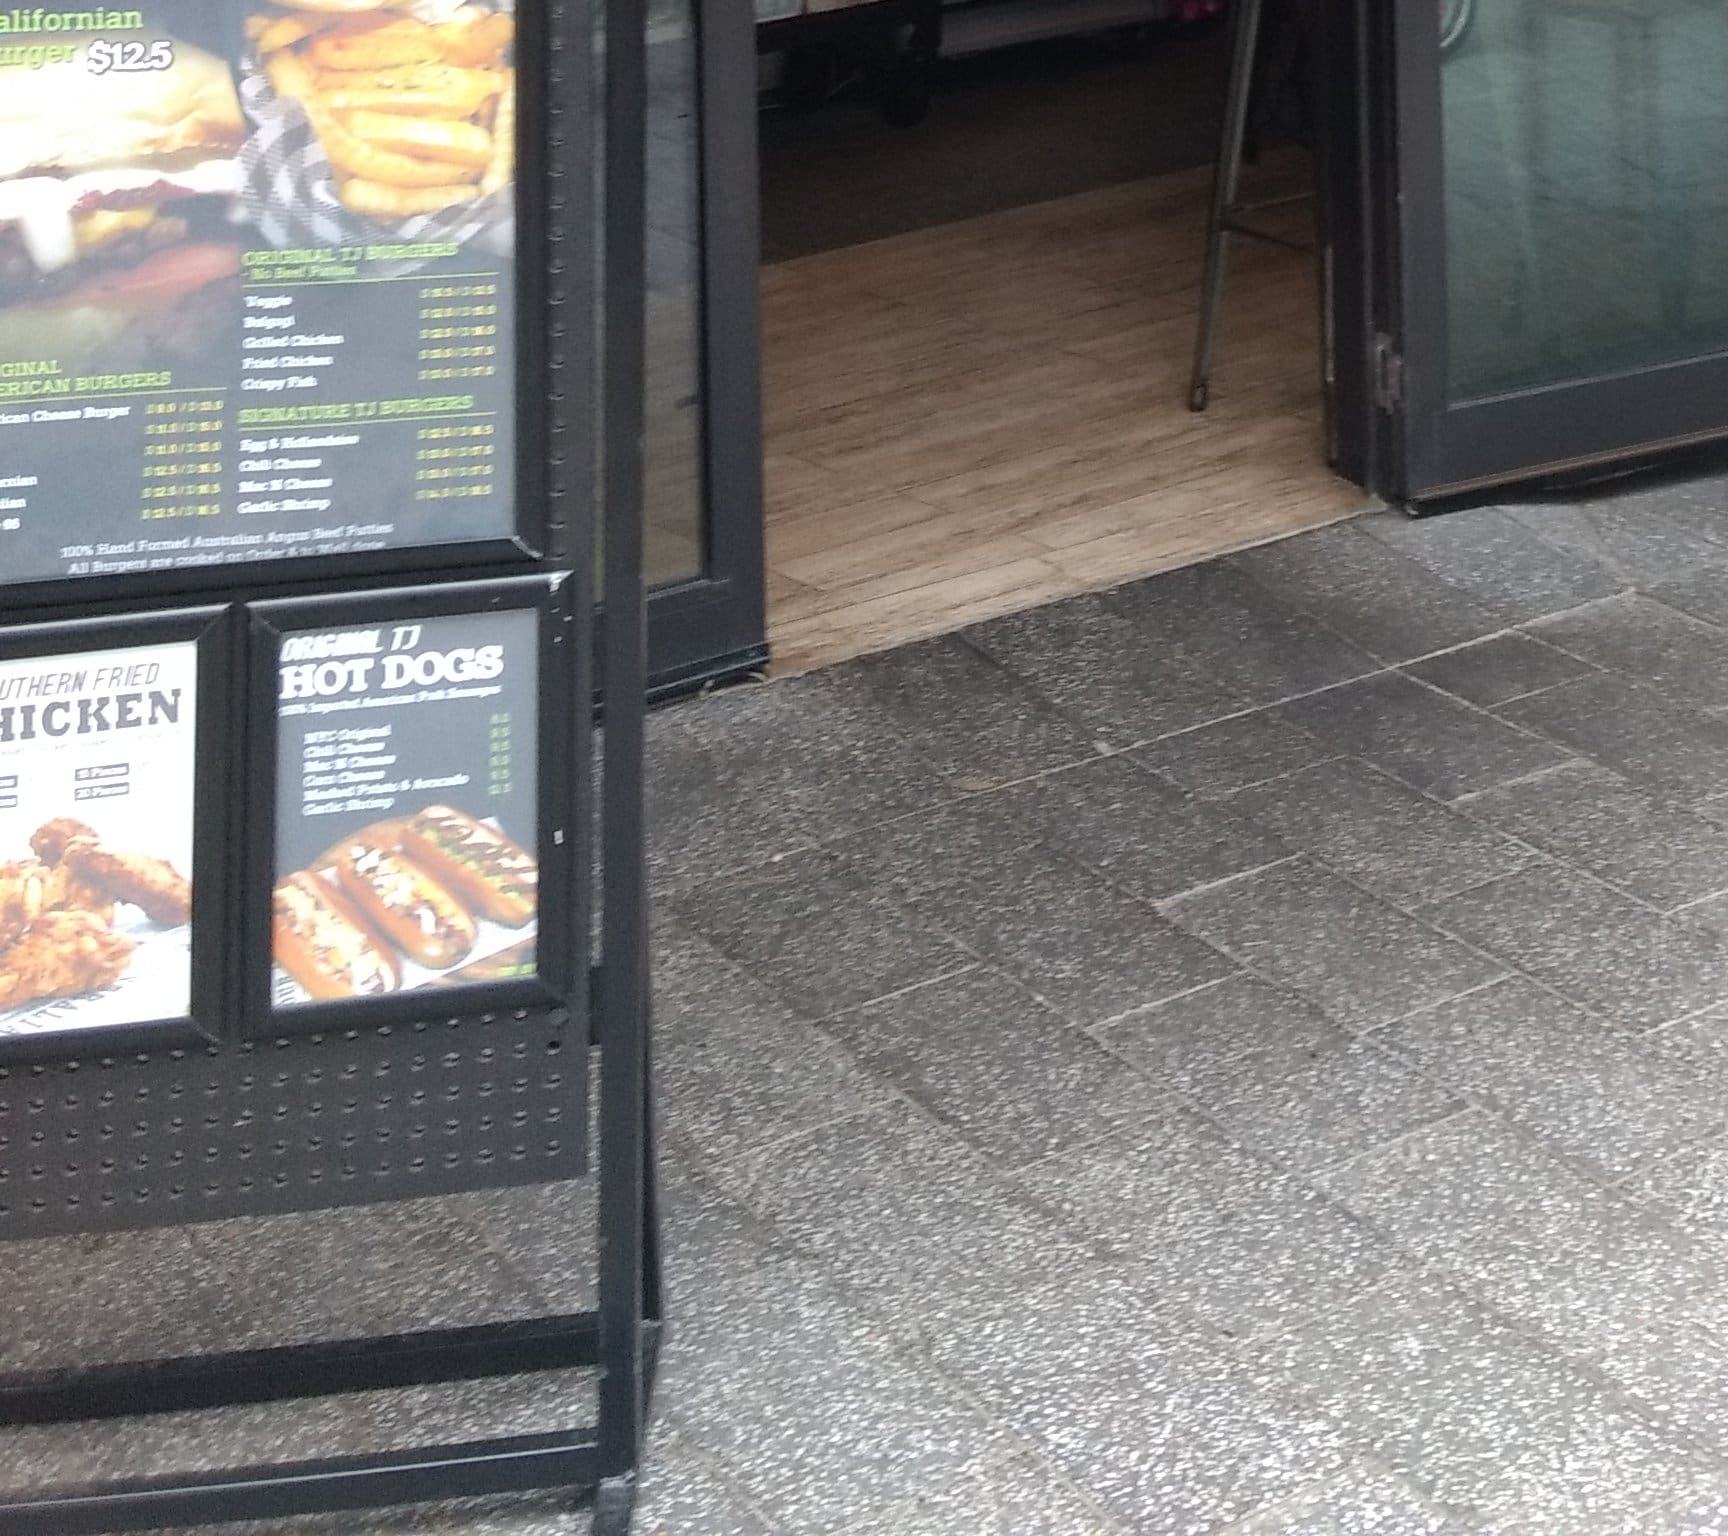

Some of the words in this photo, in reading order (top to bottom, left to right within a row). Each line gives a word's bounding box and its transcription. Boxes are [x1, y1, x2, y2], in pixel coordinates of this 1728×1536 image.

[86, 39, 174, 76] $12.5
[74, 371, 173, 392] BURGERS
[92, 662, 161, 691] FRIED
[278, 657, 375, 700] HOT
[380, 644, 505, 690] DOGS
